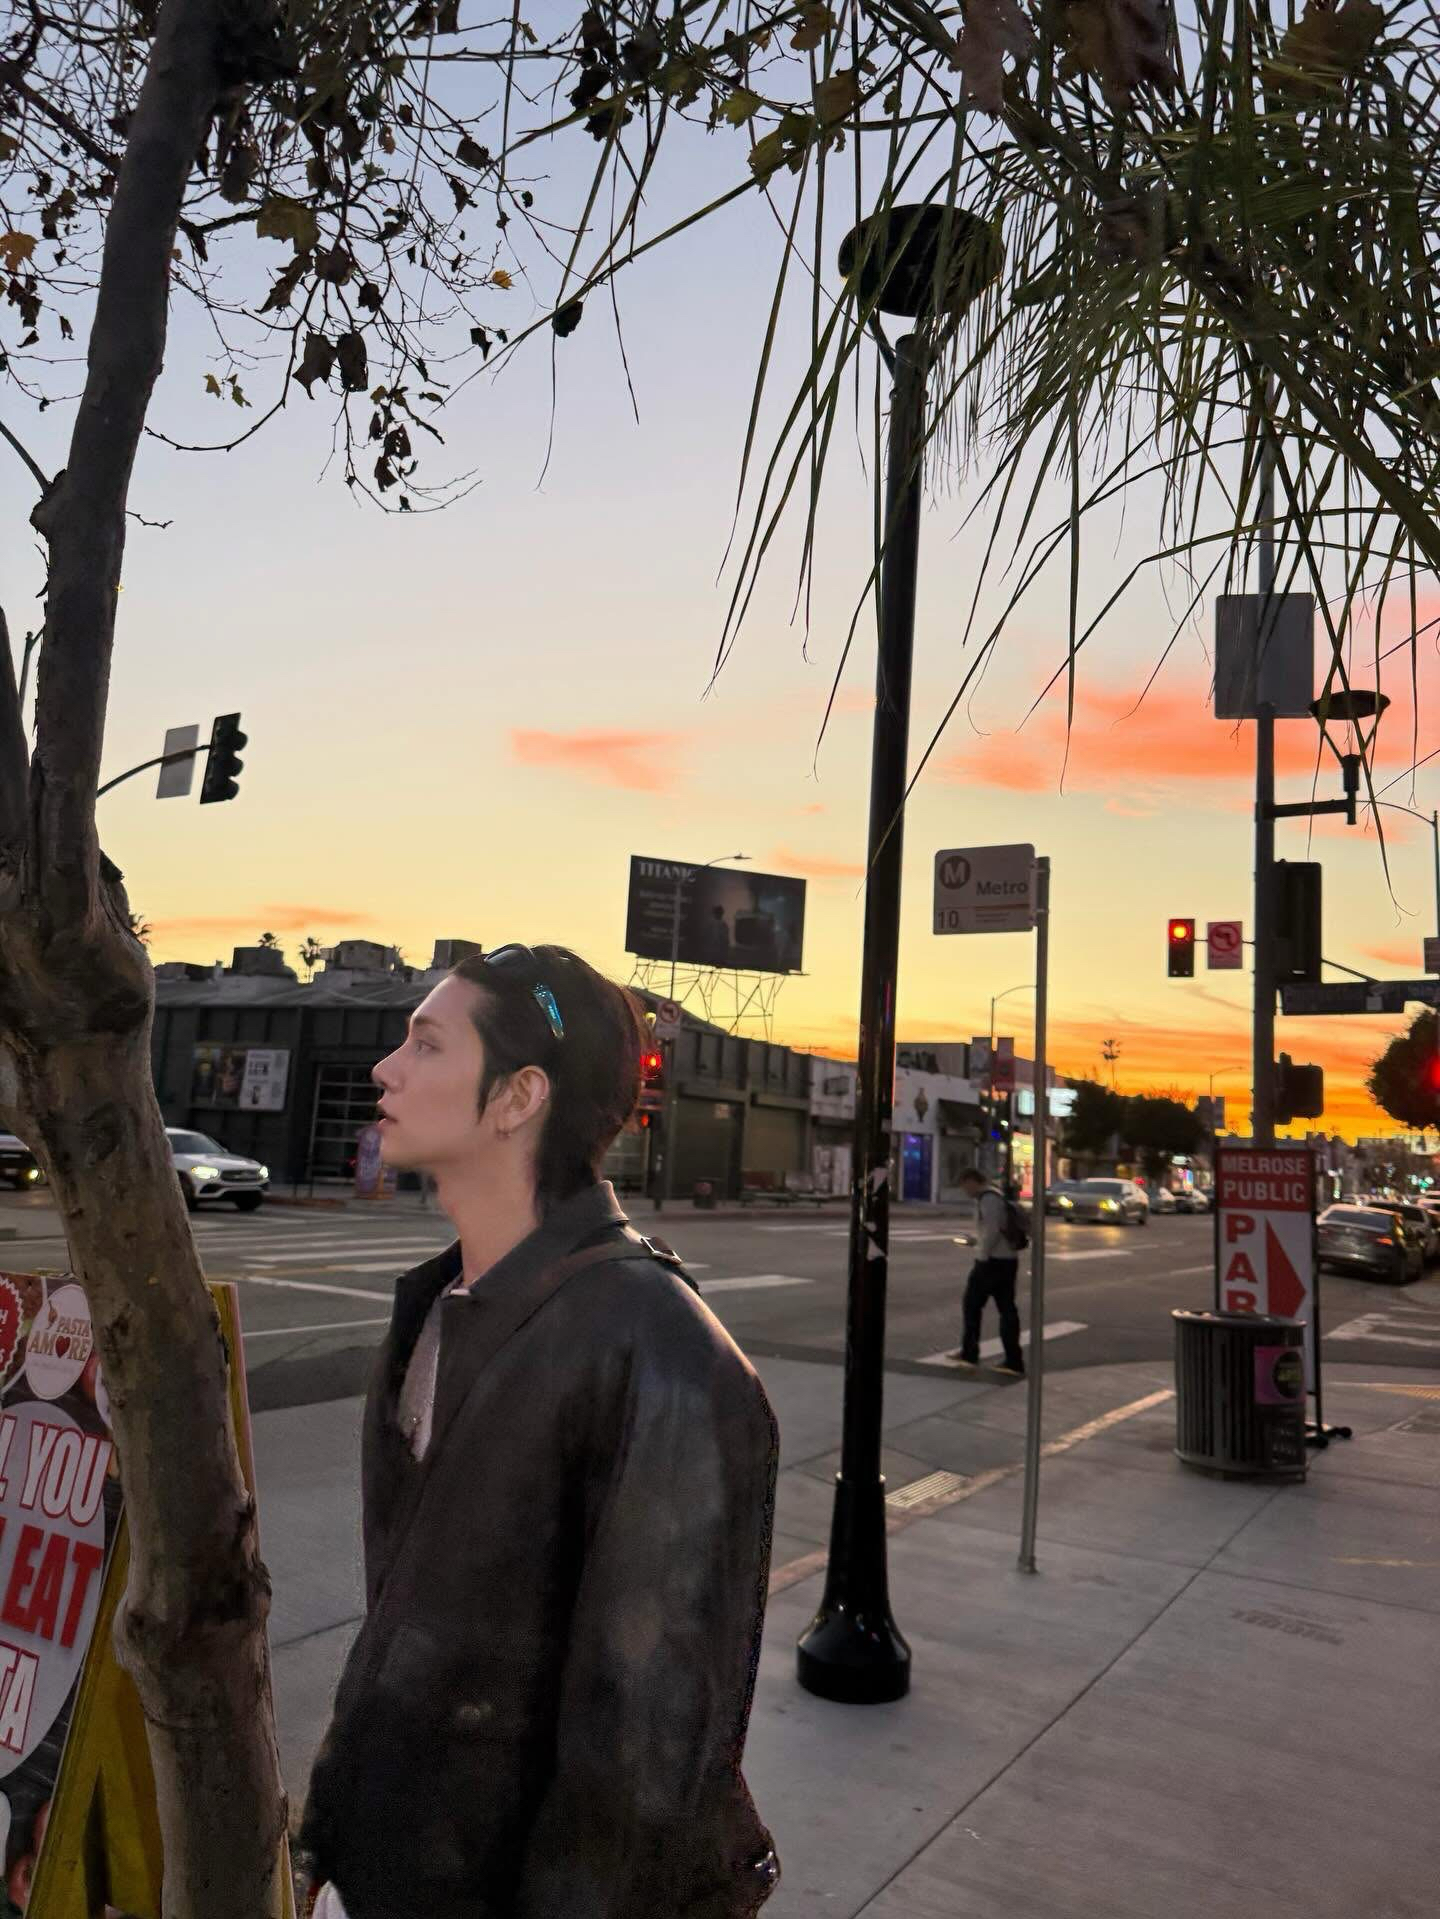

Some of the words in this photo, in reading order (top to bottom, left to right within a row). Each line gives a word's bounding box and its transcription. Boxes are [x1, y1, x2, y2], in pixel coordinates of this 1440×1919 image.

[975, 880, 1029, 897] Metro
[938, 910, 960, 930] 10
[1222, 1154, 1306, 1175] MELROSE
[1223, 1179, 1306, 1203] PUBLIC
[56, 1316, 91, 1338] PASTA
[19, 1420, 112, 1527] YOU
[1, 1524, 104, 1648] EAT
